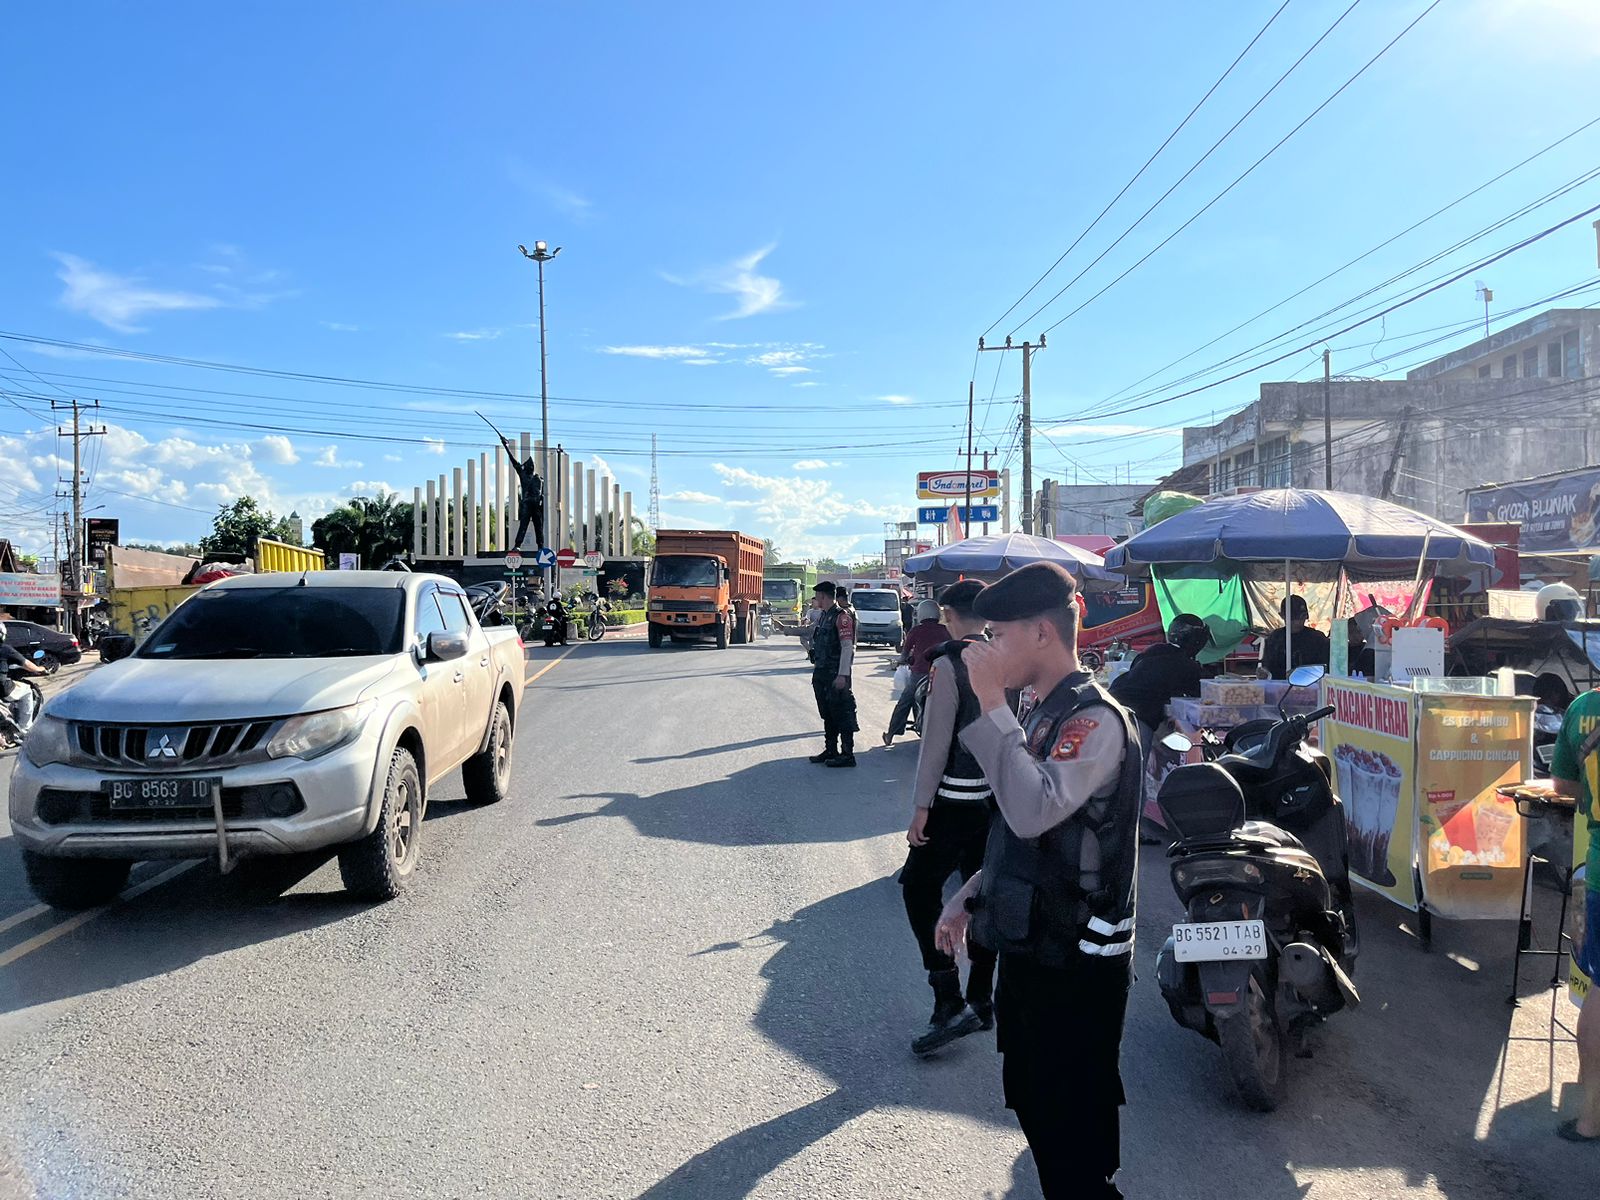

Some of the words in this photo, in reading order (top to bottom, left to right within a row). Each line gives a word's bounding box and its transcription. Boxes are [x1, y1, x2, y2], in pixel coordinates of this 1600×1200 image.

[932, 479, 984, 490] Indomret
[1497, 501, 1530, 521] GYOZA
[507, 556, 520, 564] 007
[1337, 689, 1373, 730] KACANG
[1374, 696, 1409, 738] MERAH
[1476, 715, 1509, 727] JUMBO
[1470, 732, 1478, 744] &
[113, 782, 132, 799] BG
[142, 781, 178, 798] 8563
[1176, 928, 1192, 942] BG
[1196, 926, 1228, 941] 5521
[1234, 925, 1261, 939] TAB
